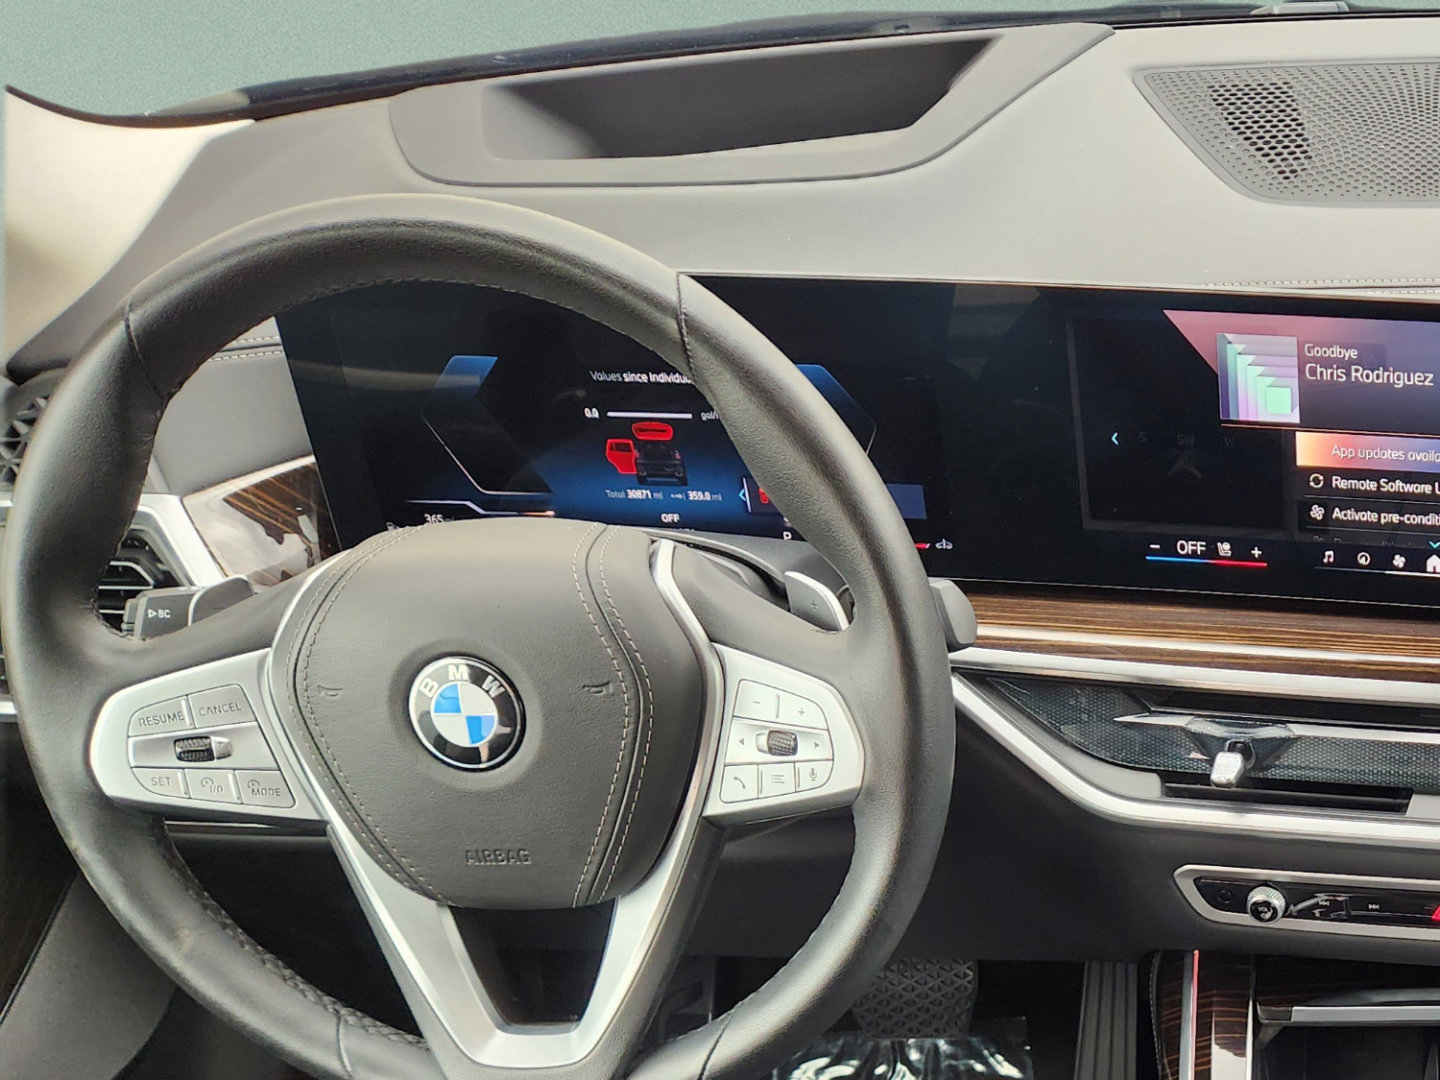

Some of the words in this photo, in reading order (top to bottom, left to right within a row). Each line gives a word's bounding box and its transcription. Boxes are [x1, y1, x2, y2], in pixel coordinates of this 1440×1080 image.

[1304, 343, 1358, 360] Goodbye
[589, 370, 622, 381] Values
[623, 371, 648, 383] since
[1304, 363, 1347, 382] Chris
[1351, 365, 1434, 387] Rodriguez
[1331, 444, 1355, 458] App
[1358, 446, 1405, 460] updates
[1331, 475, 1378, 491] Remote
[1380, 479, 1433, 494] Software
[687, 490, 711, 501] 359.0
[661, 513, 680, 523] OFF
[1331, 507, 1379, 521] Activate
[1176, 540, 1206, 555] OFF
[158, 609, 171, 618] BC
[420, 663, 506, 698] BMW
[199, 701, 242, 717] CANCEL
[138, 710, 185, 727] RESUME
[151, 776, 171, 787] SET
[251, 787, 281, 797] MODE
[465, 848, 531, 865] AIRBAG
